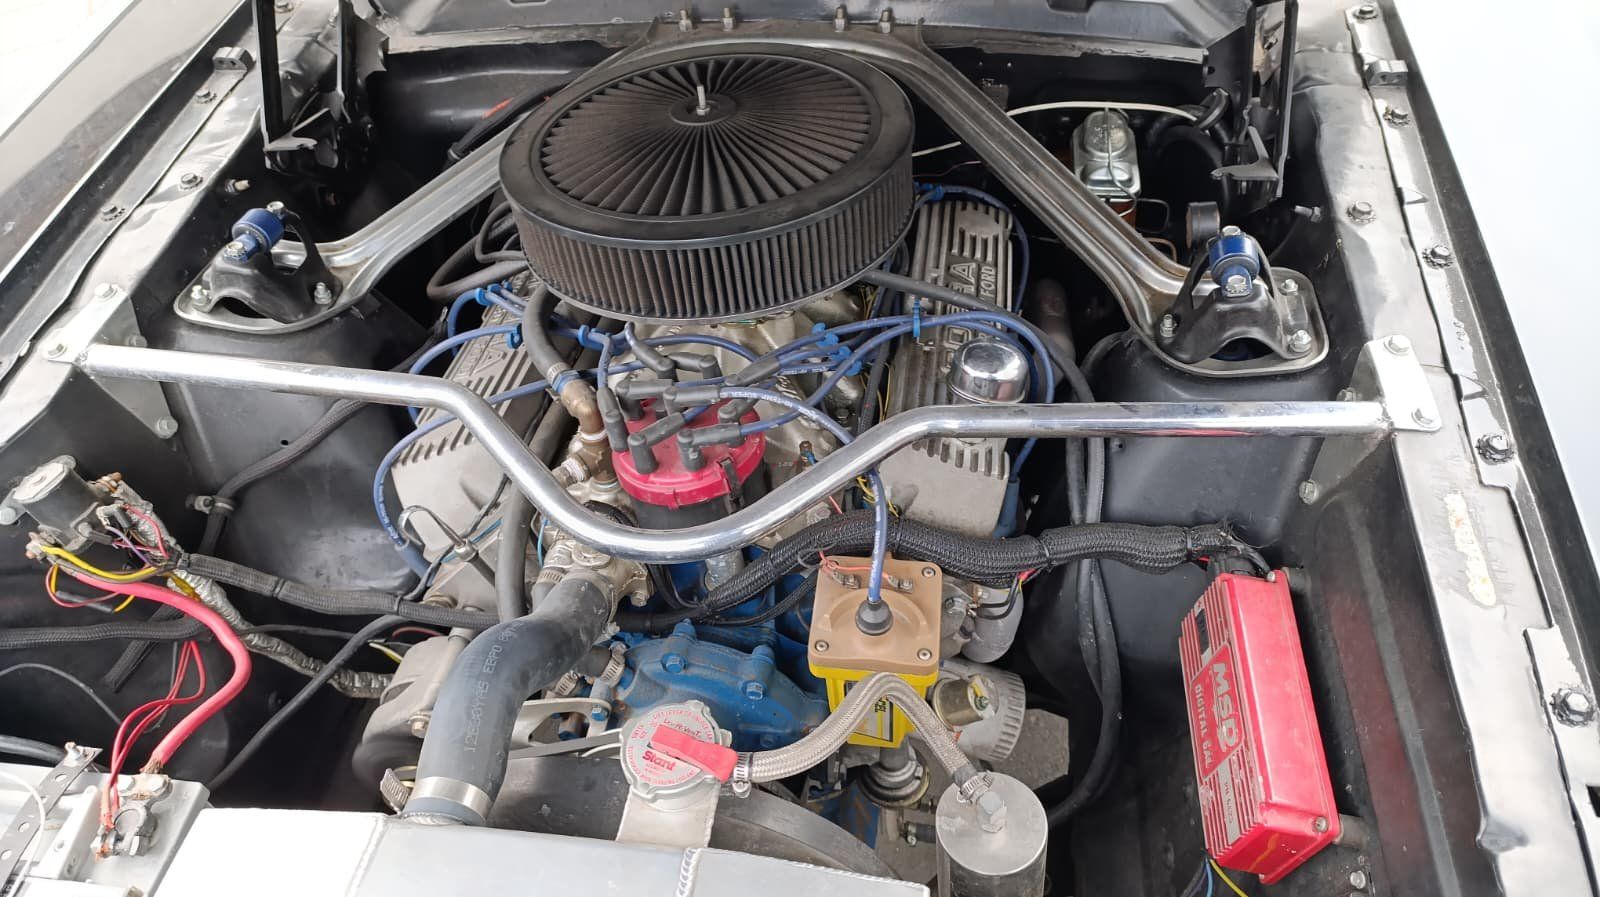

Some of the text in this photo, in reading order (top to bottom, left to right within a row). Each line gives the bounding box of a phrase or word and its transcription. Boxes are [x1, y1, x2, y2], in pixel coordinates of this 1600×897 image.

[980, 267, 996, 297] FORD
[1195, 685, 1208, 733] DIGITAL
[1212, 662, 1239, 751] MSD
[642, 750, 677, 772] Stant
